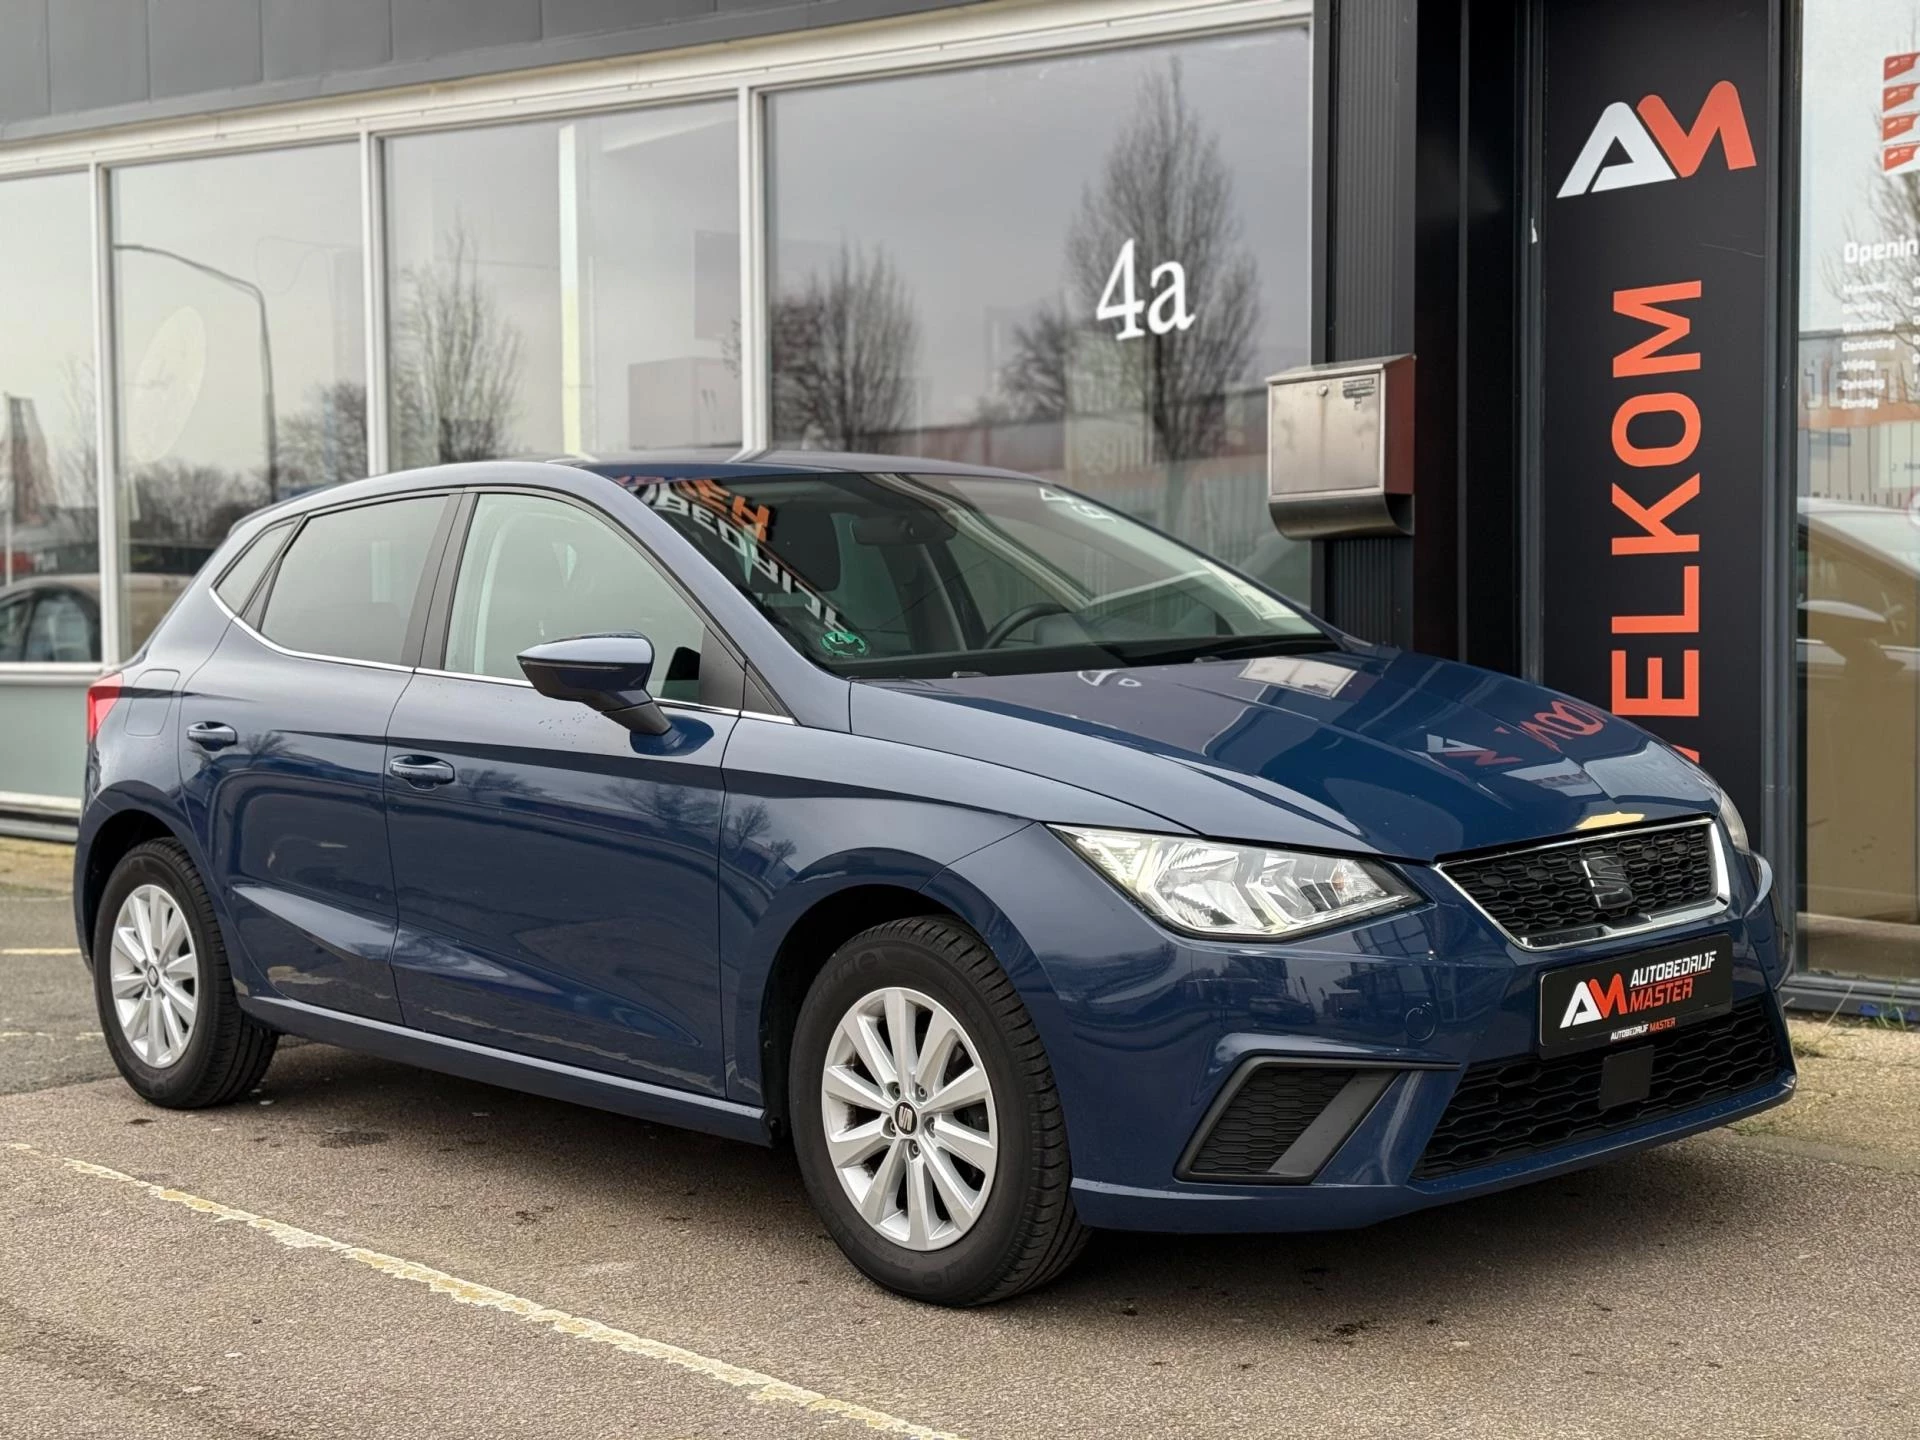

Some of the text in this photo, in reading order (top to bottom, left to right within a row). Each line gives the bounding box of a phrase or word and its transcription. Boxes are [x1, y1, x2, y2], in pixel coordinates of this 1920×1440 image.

[1096, 238, 1196, 341] 4a
[1611, 280, 1702, 763] ELKOM
[1629, 950, 1718, 988] AUTOBEDRIJF
[1629, 977, 1693, 1013] MASTER
[1610, 1017, 1676, 1041] AUTOBEDRIJF MASTER
